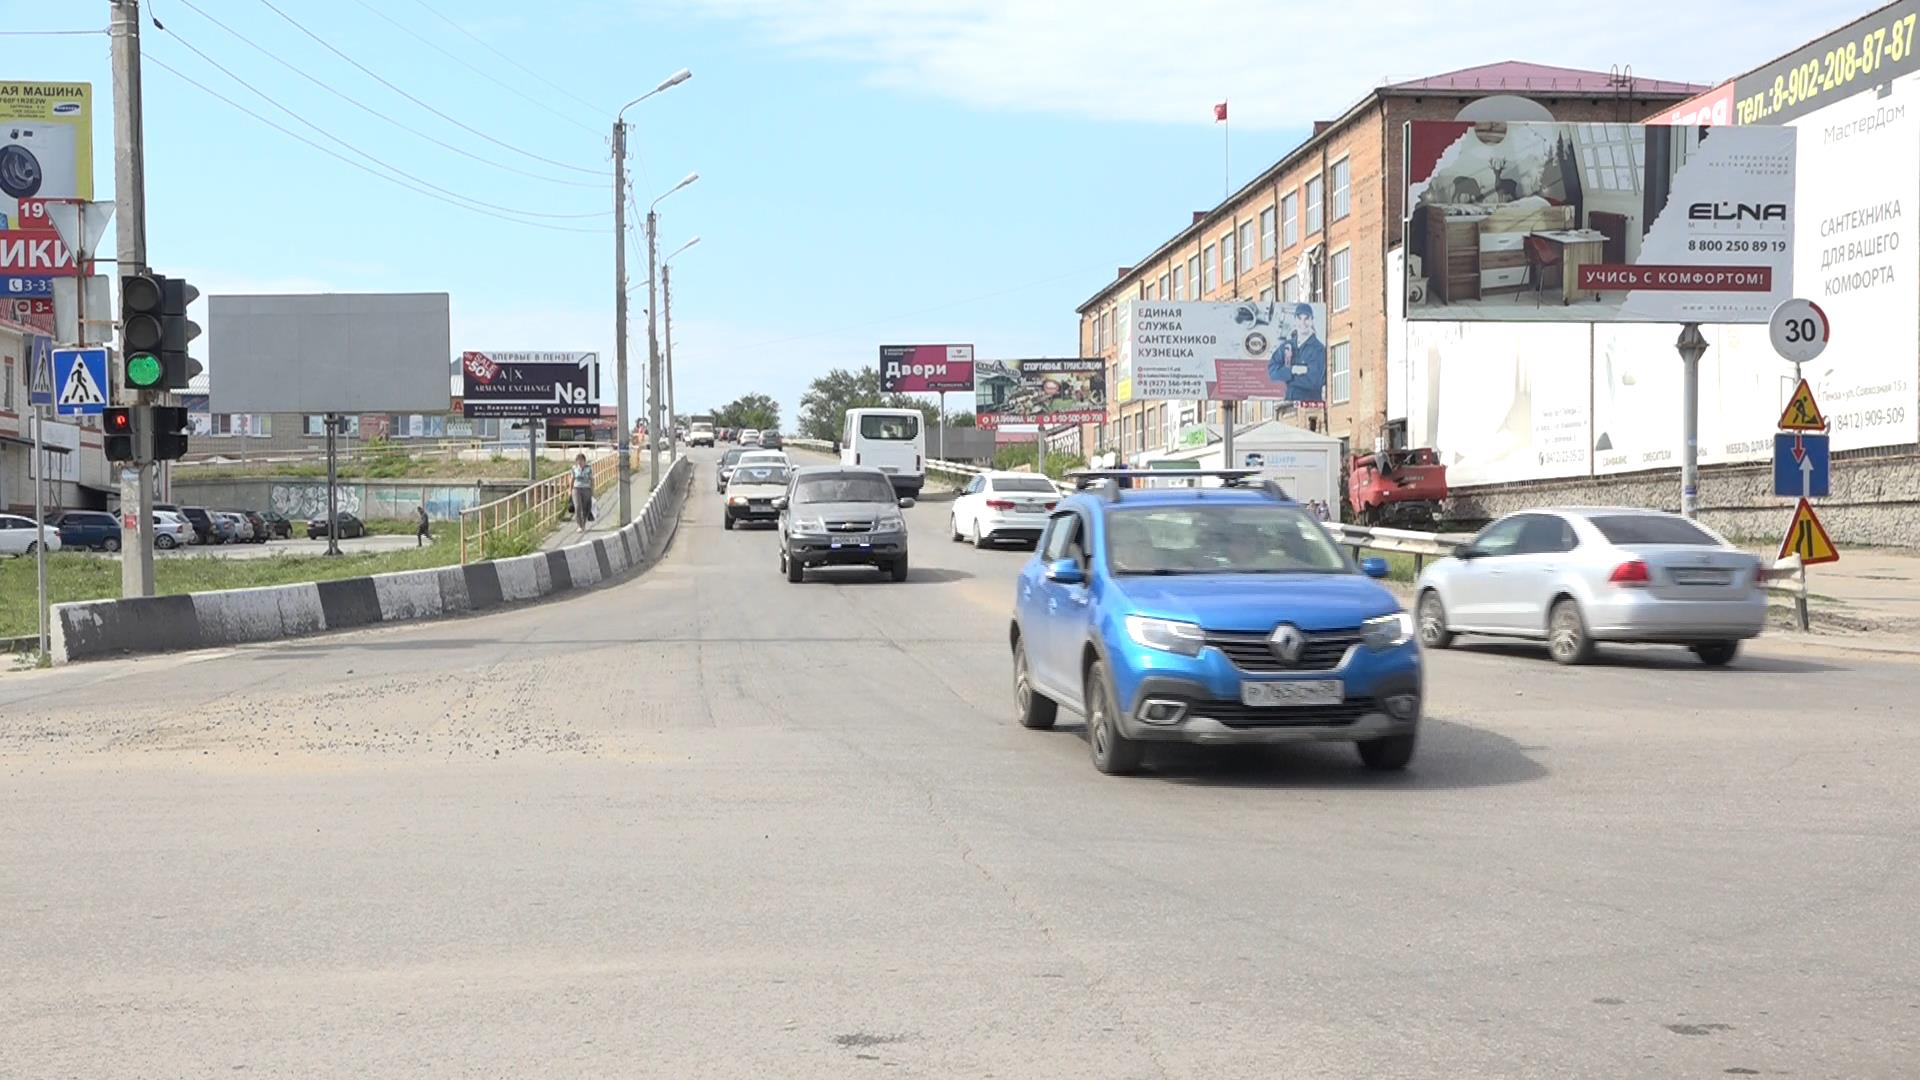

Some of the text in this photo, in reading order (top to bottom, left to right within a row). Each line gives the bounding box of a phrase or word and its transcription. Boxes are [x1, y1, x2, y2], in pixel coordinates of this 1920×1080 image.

[23, 86, 84, 97] МАШИНА
[1824, 105, 1905, 144] МастерДом
[20, 202, 45, 218] 19
[1820, 199, 1902, 238] САНТЕХНИКА
[1688, 240, 1786, 252] 8 800 250 89 19
[1820, 232, 1900, 272] ДЛЯ ВАШЕГО
[1586, 271, 1764, 285] УЧИСЬ С КОМФОРТОМ!
[1824, 265, 1895, 296] КОМФОРТА
[1138, 308, 1182, 318] ЕДИНАЯ
[1138, 321, 1182, 331] СЛУЖБА
[1785, 318, 1816, 343] 30
[1138, 335, 1217, 344] САНТЕХНИКОВ
[492, 353, 575, 361] ВПЕРВЫЕ В ПЕНЗЕ!
[1138, 348, 1194, 358] КУЗНЕЦКА
[474, 354, 498, 372] SALE
[886, 362, 947, 379] Двери
[1834, 407, 1905, 432] (8412) 909-509
